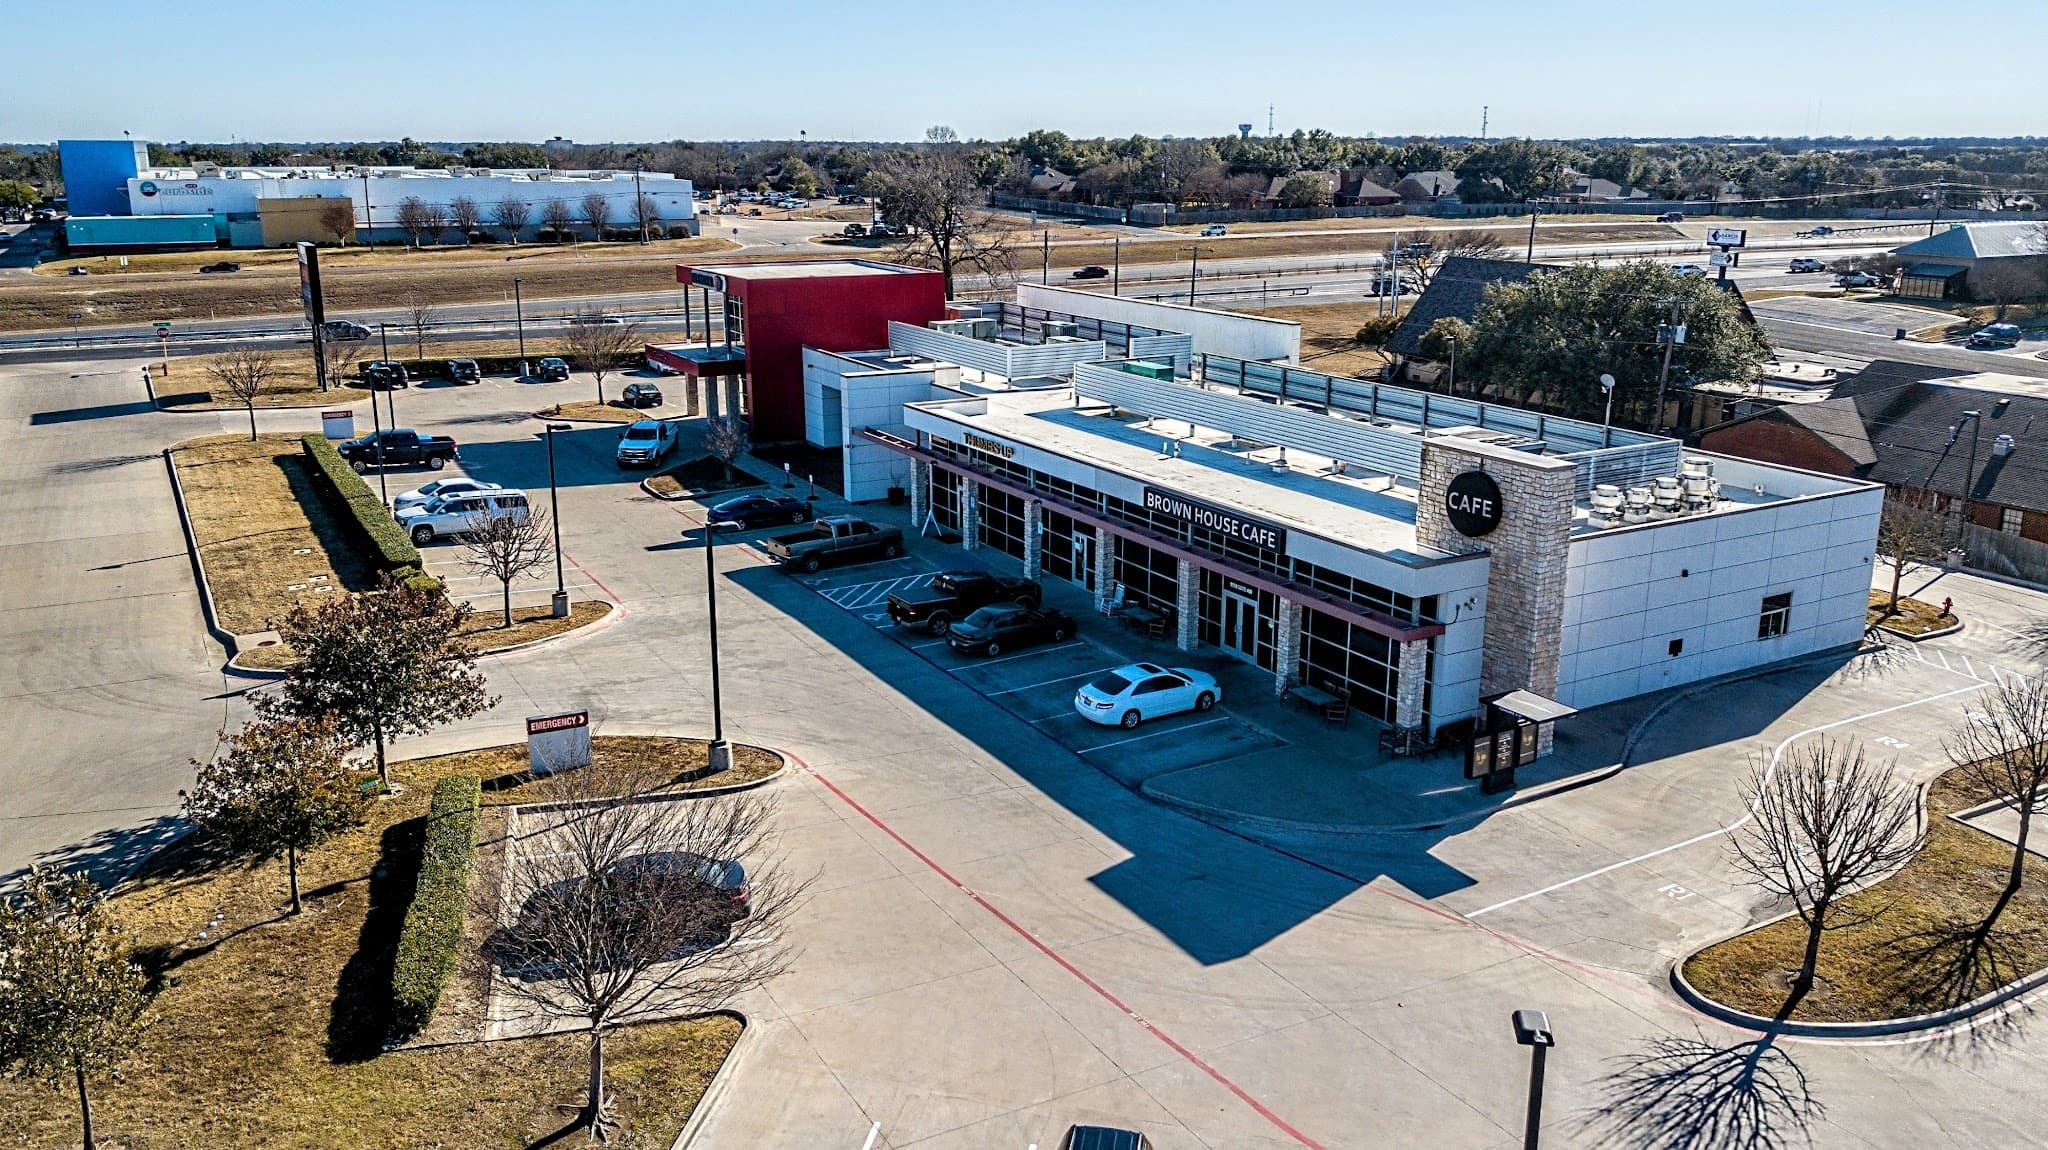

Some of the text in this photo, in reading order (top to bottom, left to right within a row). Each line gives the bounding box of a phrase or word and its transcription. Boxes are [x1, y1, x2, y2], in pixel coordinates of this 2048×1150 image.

[963, 432, 1014, 458] THUMBS UP
[1448, 491, 1493, 519] CAFE
[1147, 492, 1276, 549] BROWN HOUSE CAFE
[530, 716, 577, 732] EMERGENCY
